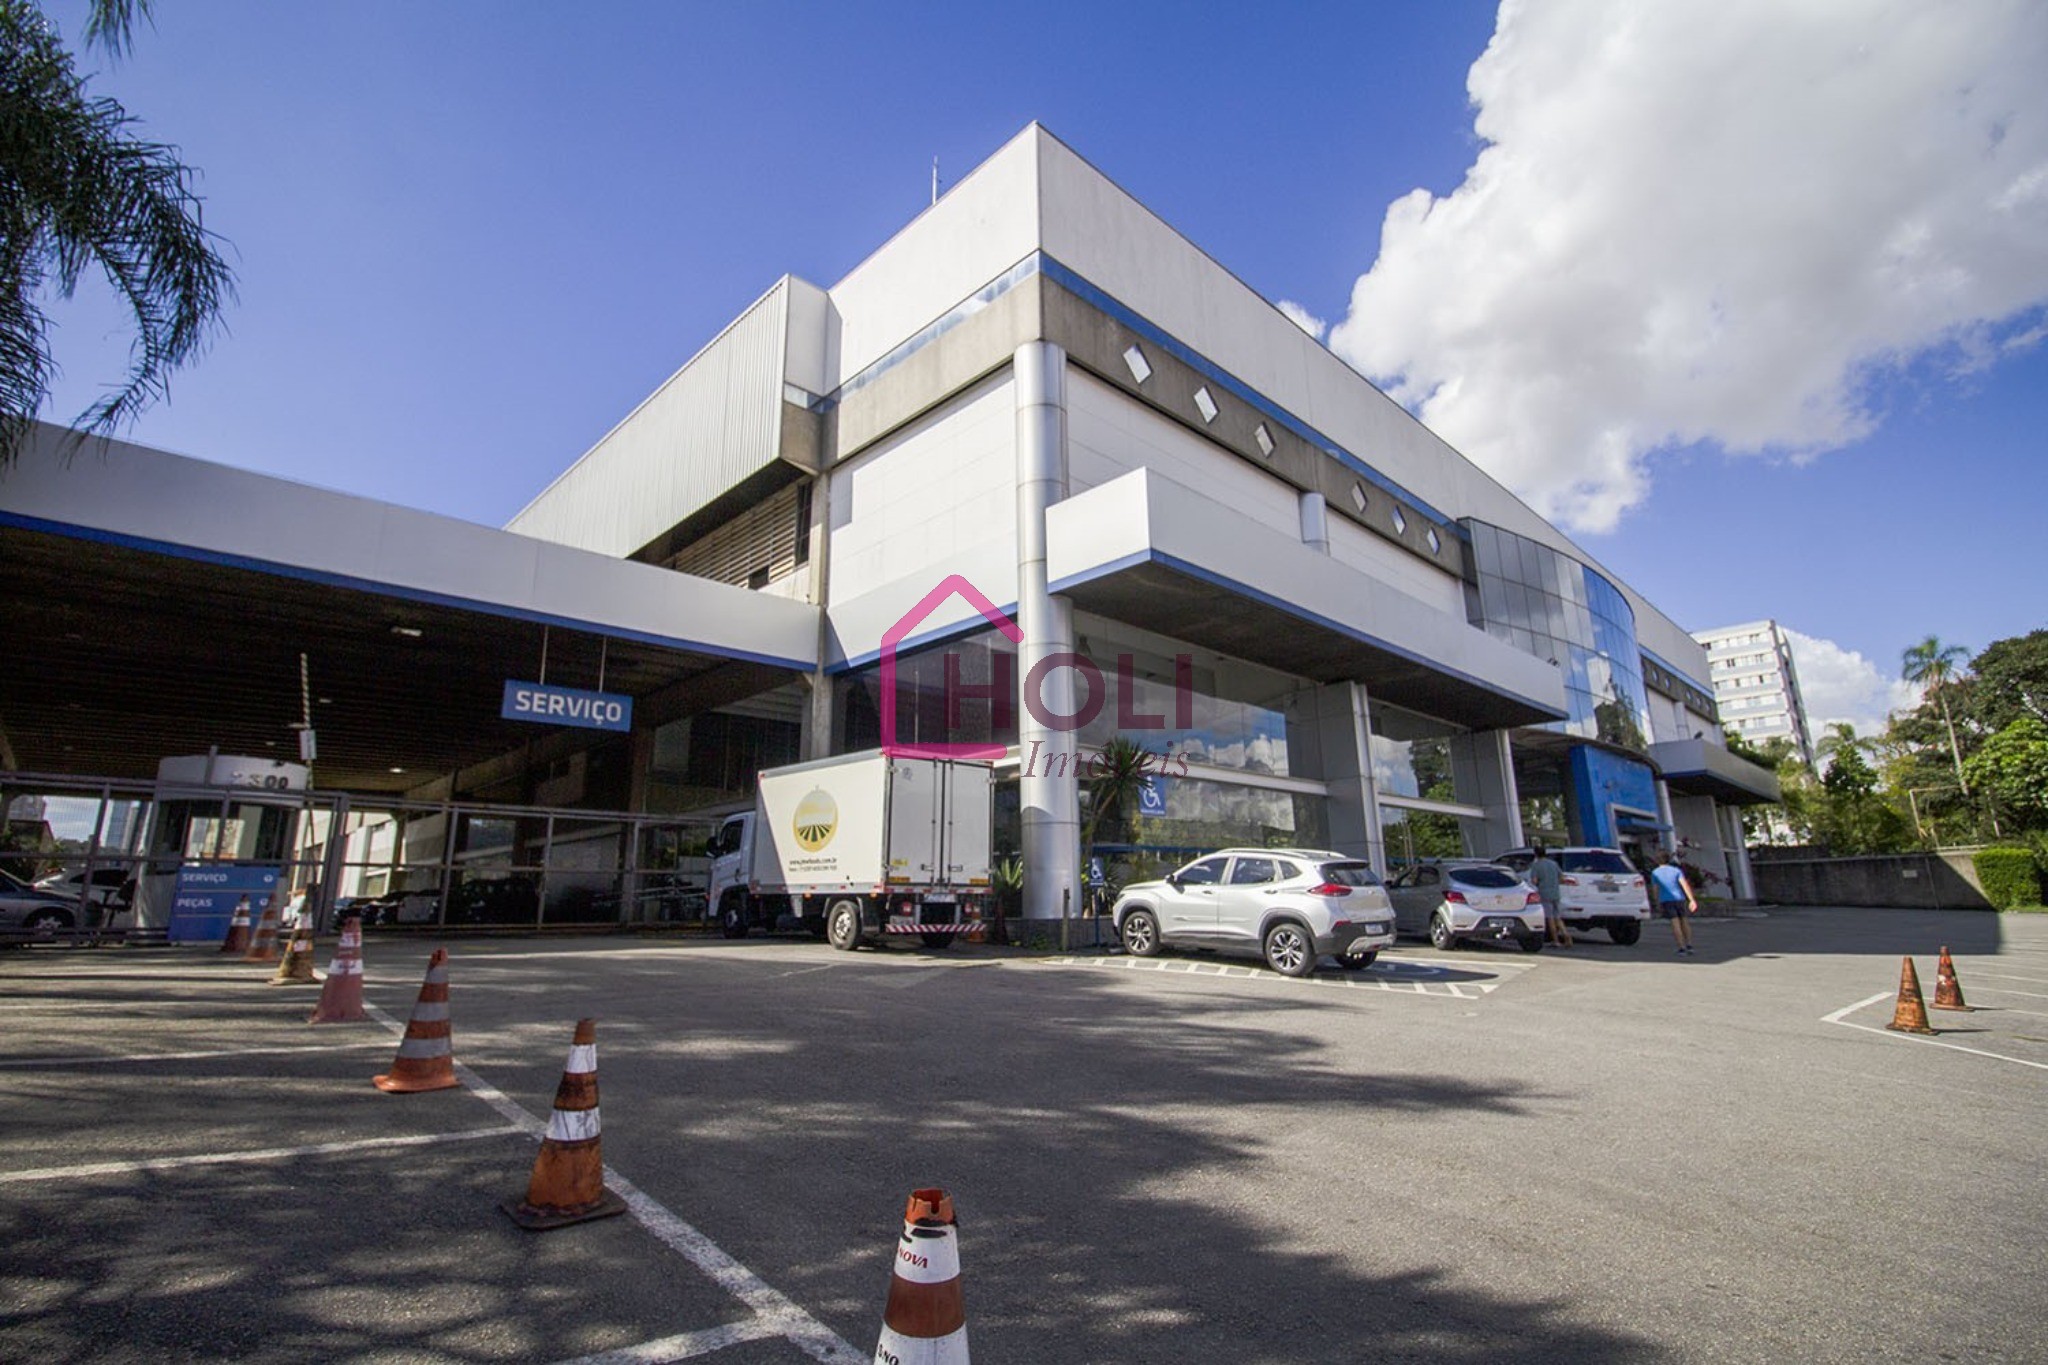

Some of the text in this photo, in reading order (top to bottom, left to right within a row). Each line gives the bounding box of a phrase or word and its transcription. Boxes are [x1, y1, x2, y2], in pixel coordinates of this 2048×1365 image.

[515, 690, 623, 725] SERVIÇO
[182, 873, 228, 883] SERVIÇO
[177, 898, 213, 909] PEÇAS
